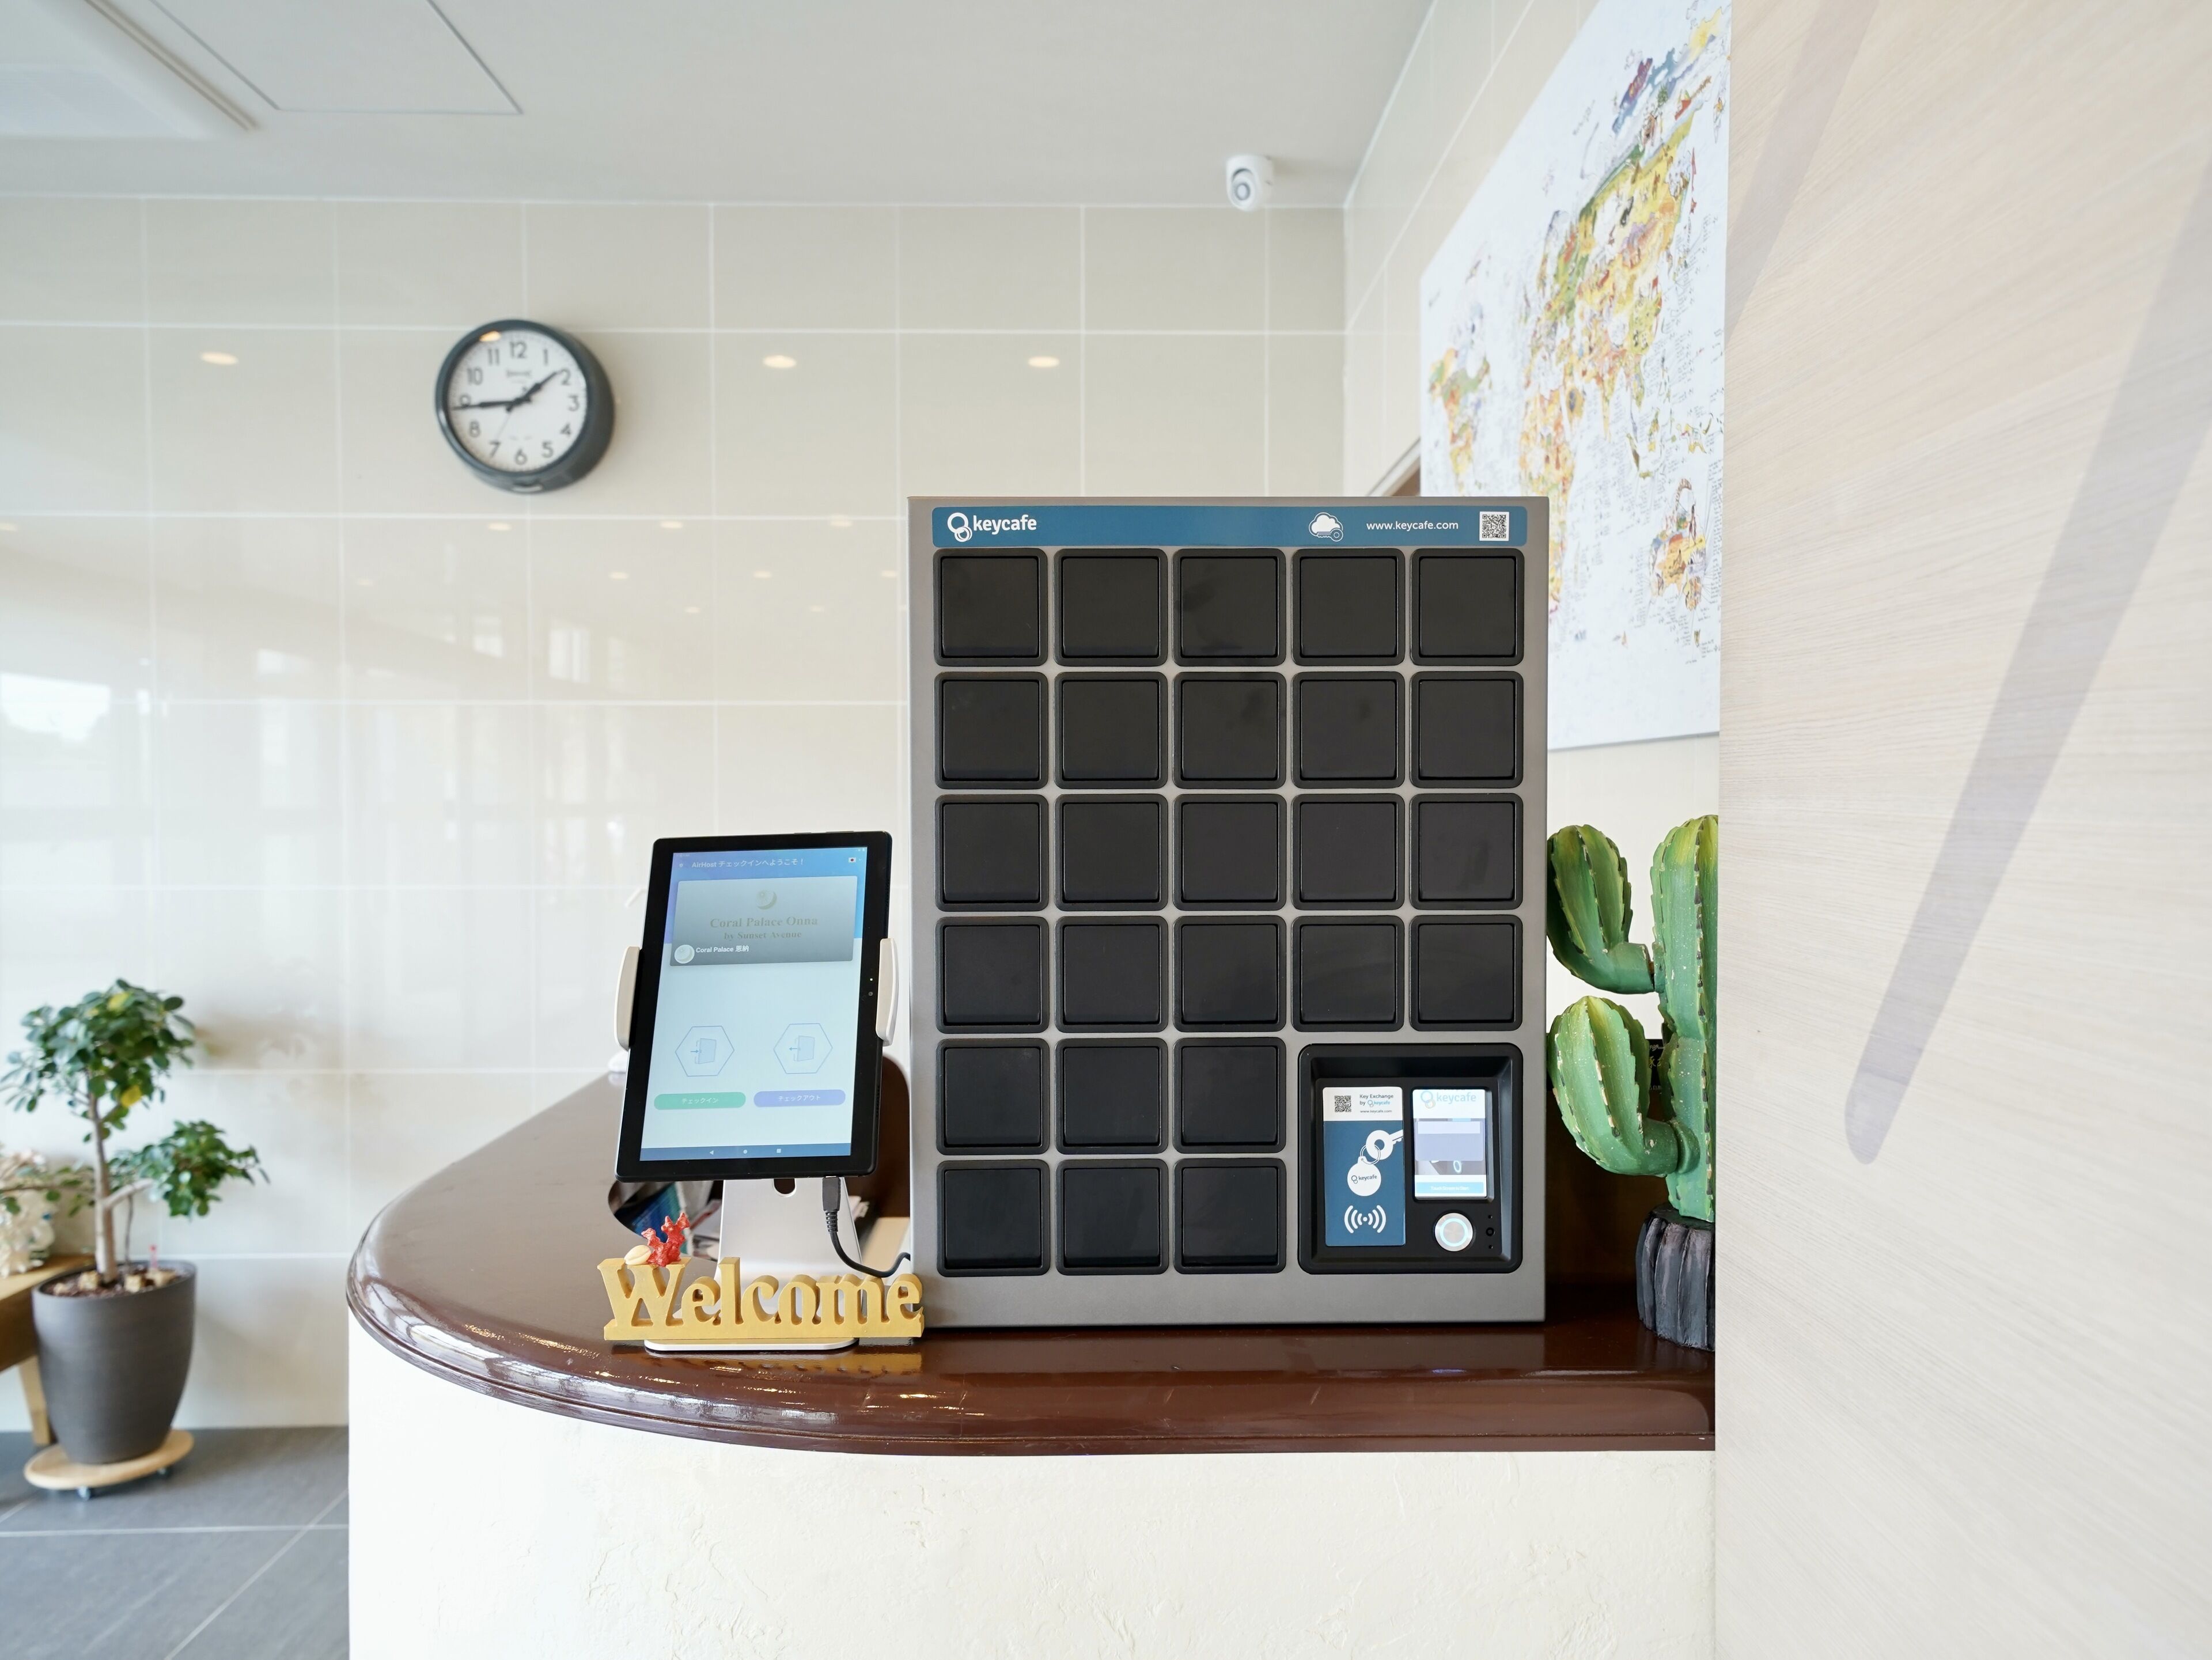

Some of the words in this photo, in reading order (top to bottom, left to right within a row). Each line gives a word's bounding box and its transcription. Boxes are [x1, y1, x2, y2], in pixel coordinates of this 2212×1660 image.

[488, 348, 499, 365] 11
[510, 342, 527, 358] 12
[543, 348, 548, 366] 1
[467, 367, 483, 385] 10
[559, 368, 571, 385] 2
[568, 394, 579, 411] 3
[469, 420, 480, 437] 8
[560, 423, 571, 435] 4
[489, 441, 501, 458] 7
[515, 449, 527, 465] 6
[541, 441, 554, 458] 5
[973, 514, 1037, 535] keycafe
[1366, 521, 1459, 532] www.keycafe.com
[710, 918, 743, 928] Coral
[747, 917, 783, 927] Palace
[786, 916, 817, 926] Onna
[724, 932, 734, 941] by
[737, 931, 767, 939] Sunset
[771, 931, 802, 939] Avenue
[1437, 1092, 1476, 1104] keycafe
[597, 1257, 924, 1327] Welcome
